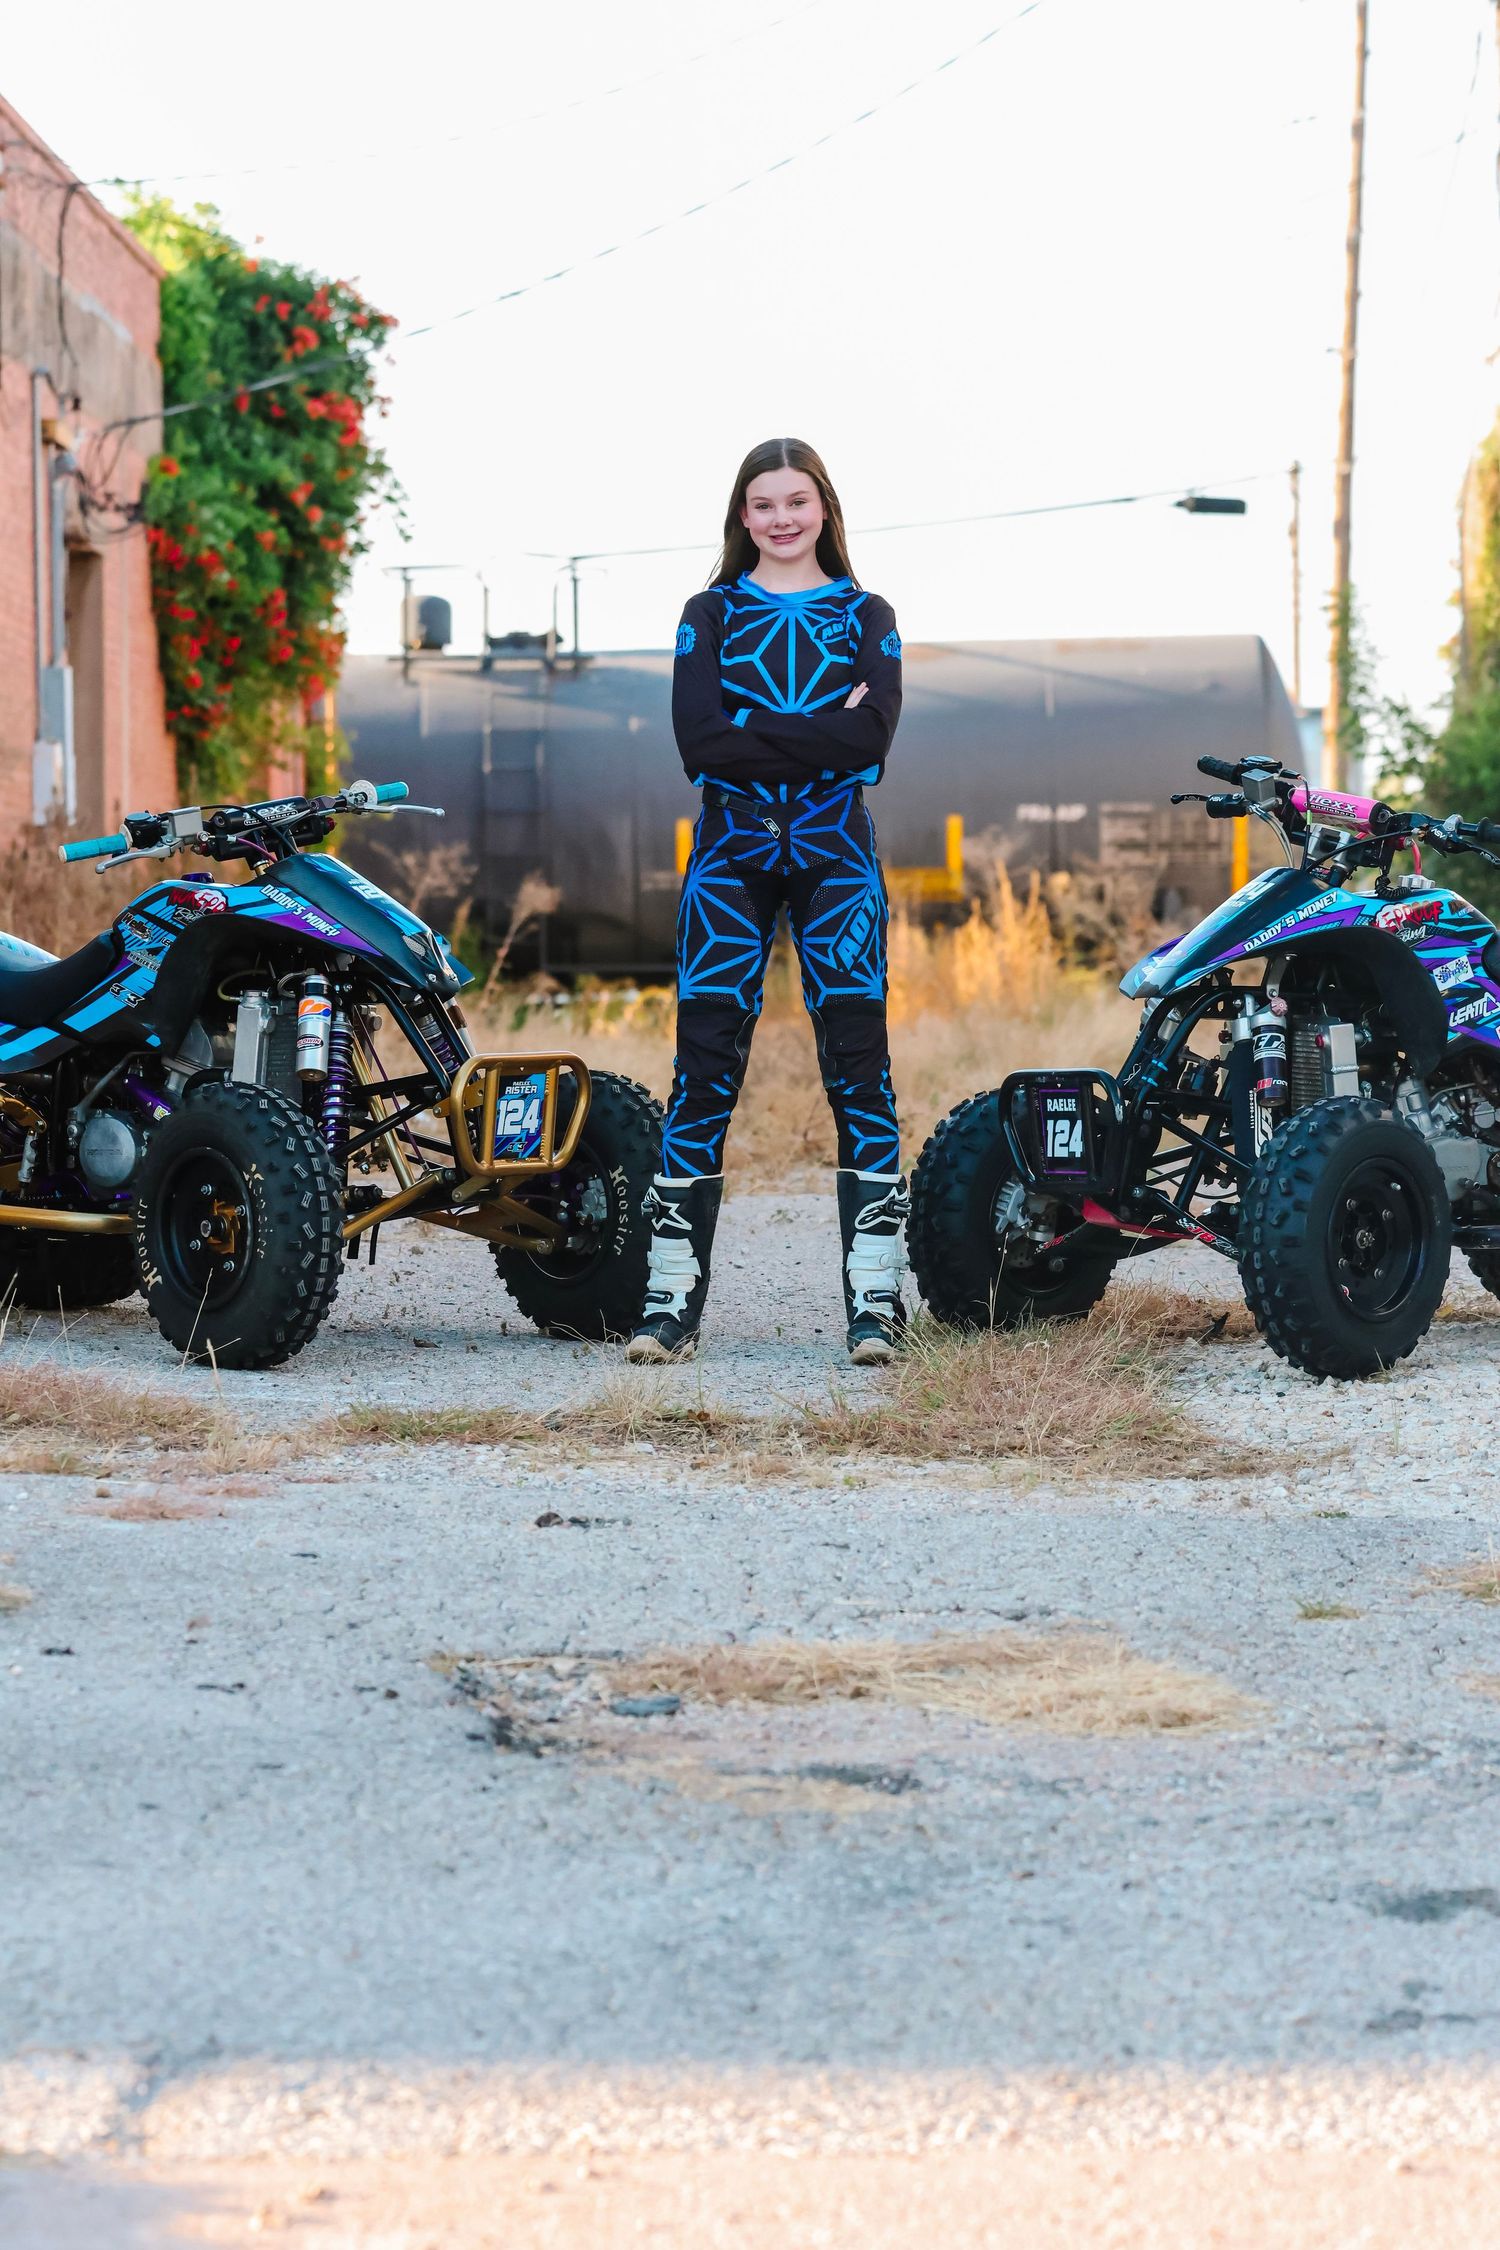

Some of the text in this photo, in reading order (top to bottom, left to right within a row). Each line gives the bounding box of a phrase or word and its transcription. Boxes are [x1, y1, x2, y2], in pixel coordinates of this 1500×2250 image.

[260, 883, 341, 937] DADDY'S MONEY
[836, 887, 877, 972] AOT
[1243, 890, 1338, 952] DADDY'S MONEY
[504, 1085, 538, 1095] RISTER
[1046, 1098, 1077, 1112] RAELEE
[496, 1098, 540, 1136] 124
[1046, 1119, 1083, 1158] 124
